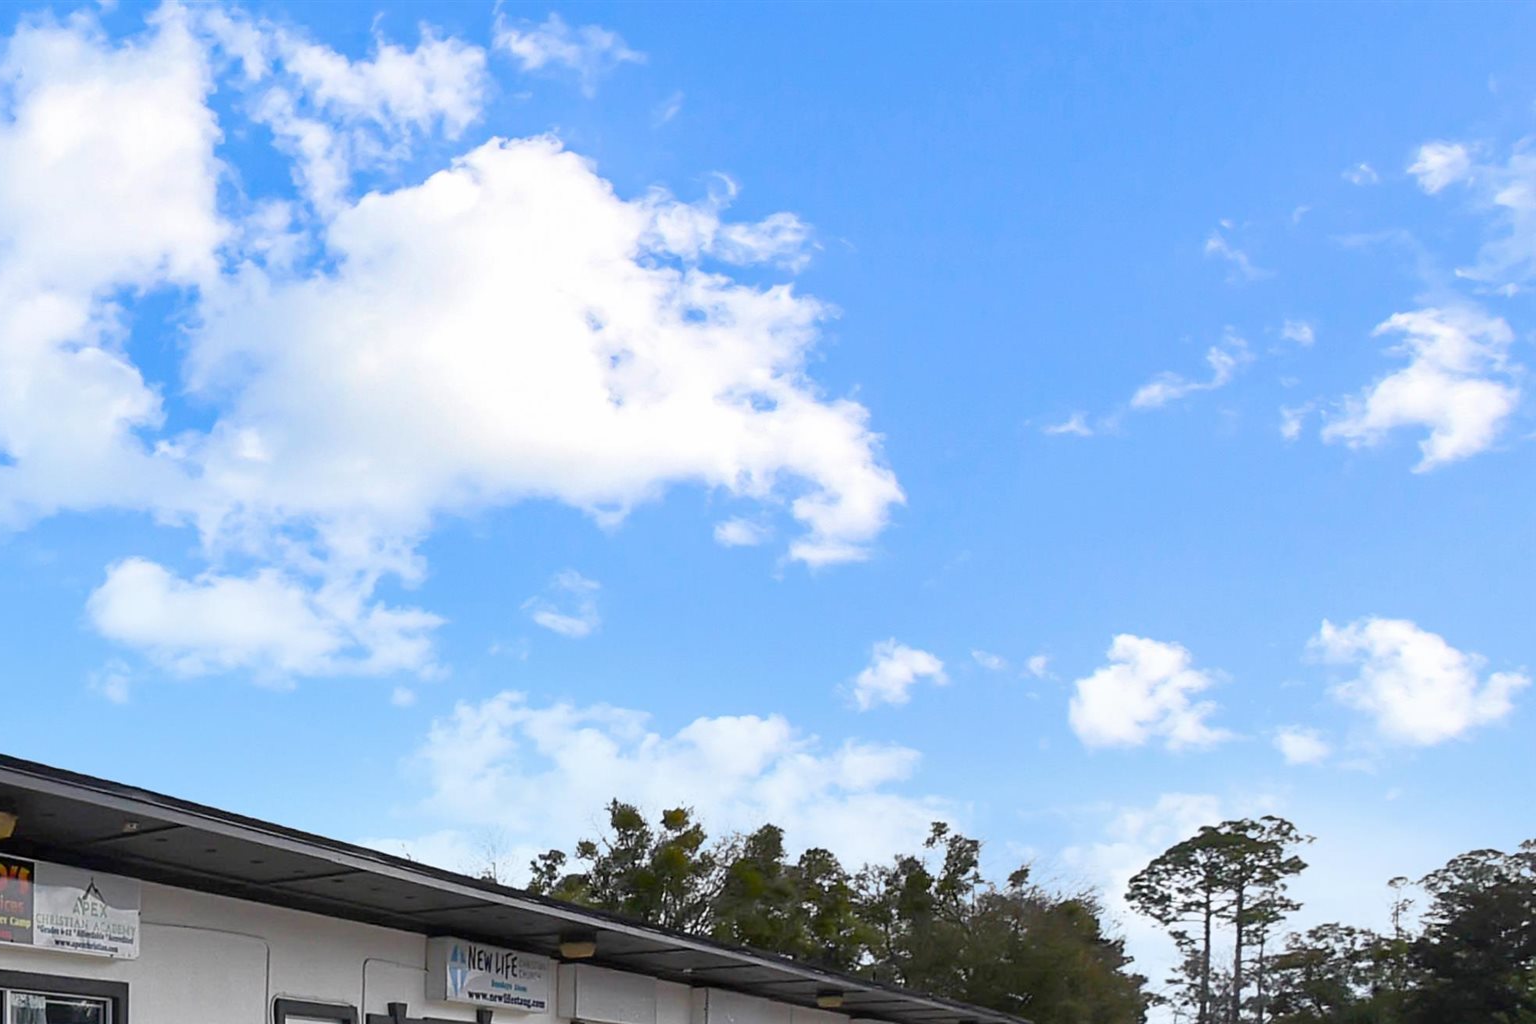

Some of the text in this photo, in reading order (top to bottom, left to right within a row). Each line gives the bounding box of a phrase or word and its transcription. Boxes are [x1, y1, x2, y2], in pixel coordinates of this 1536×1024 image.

[73, 896, 108, 918] APEX
[9, 916, 31, 930] Camp
[36, 914, 136, 936] CHRISTIAN ACADEMY
[468, 945, 518, 979] NEW LIFE
